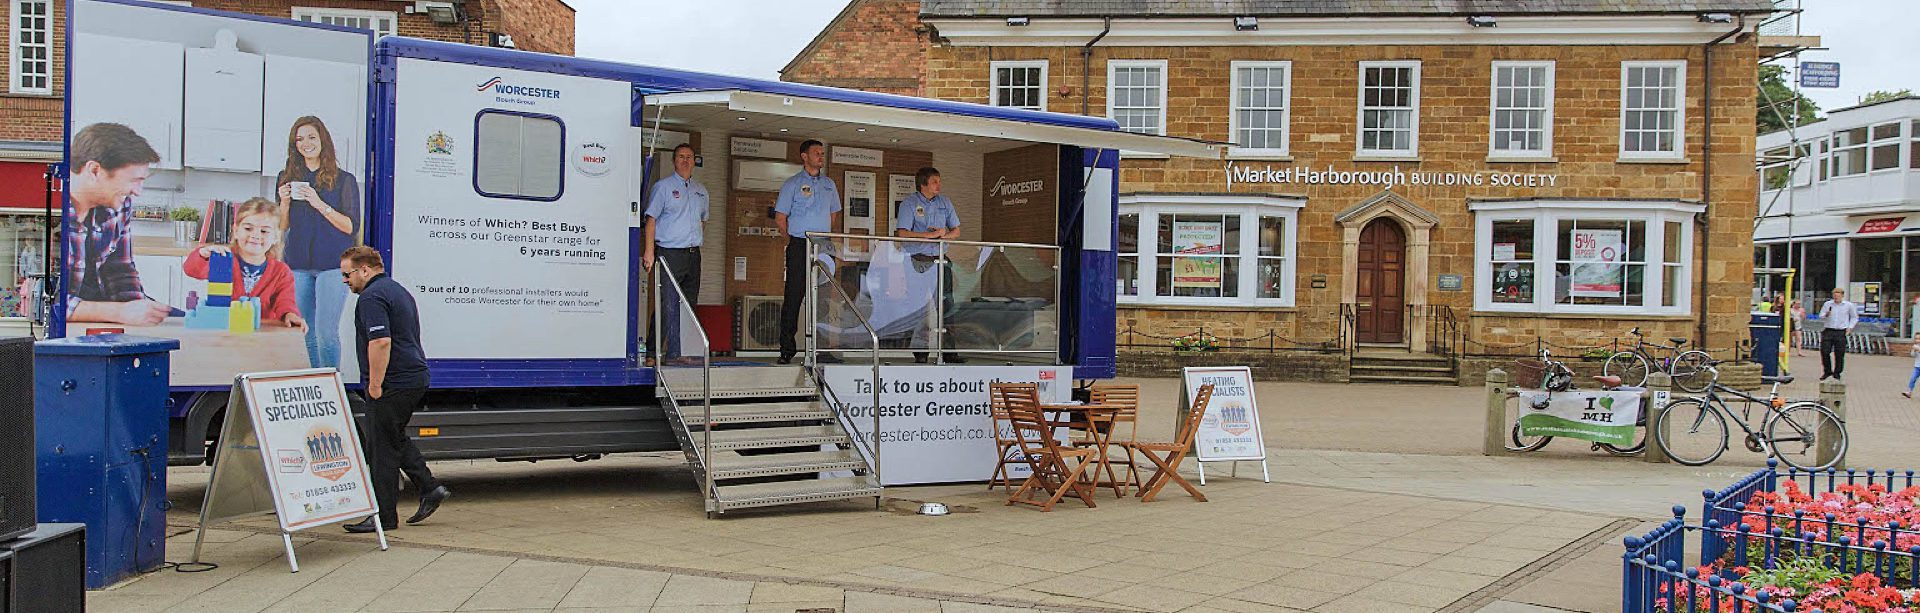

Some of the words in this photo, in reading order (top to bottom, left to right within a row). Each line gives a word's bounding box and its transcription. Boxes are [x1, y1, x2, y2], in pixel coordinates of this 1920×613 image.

[496, 84, 560, 98] WORCESTER
[1234, 165, 1292, 183] Market
[1296, 166, 1405, 190] Harborough
[1411, 172, 1483, 185] BUILDING
[1490, 174, 1557, 186] SOCIETY
[1001, 180, 1044, 196] WORCESTER
[418, 216, 466, 226] Winners
[470, 218, 481, 227] of
[485, 218, 528, 228] Which?
[532, 221, 556, 232] Best
[560, 222, 586, 234] Buys
[429, 230, 466, 240] across
[470, 232, 490, 240] our
[494, 232, 549, 243] Greenstar
[553, 236, 582, 247] range
[586, 236, 600, 246] for
[1575, 233, 1596, 248] 5%
[520, 246, 527, 255] 6
[530, 248, 560, 258] years
[564, 249, 606, 260] running
[472, 287, 524, 296] professional
[526, 288, 562, 296] installers
[444, 296, 476, 304] choose
[478, 297, 521, 305] Worcester
[538, 298, 556, 306] their
[854, 378, 888, 394] Tak
[894, 380, 910, 394] to
[916, 382, 934, 394] us
[940, 378, 984, 393] about
[1202, 376, 1236, 386] HEATING
[273, 386, 322, 403] HEATING
[1196, 386, 1245, 396] CIALISTS
[926, 402, 1000, 418] Greensty
[1584, 397, 1596, 410] I
[266, 401, 336, 422] SPECIALISTS
[1581, 412, 1614, 422] MH
[306, 488, 329, 498] 01858
